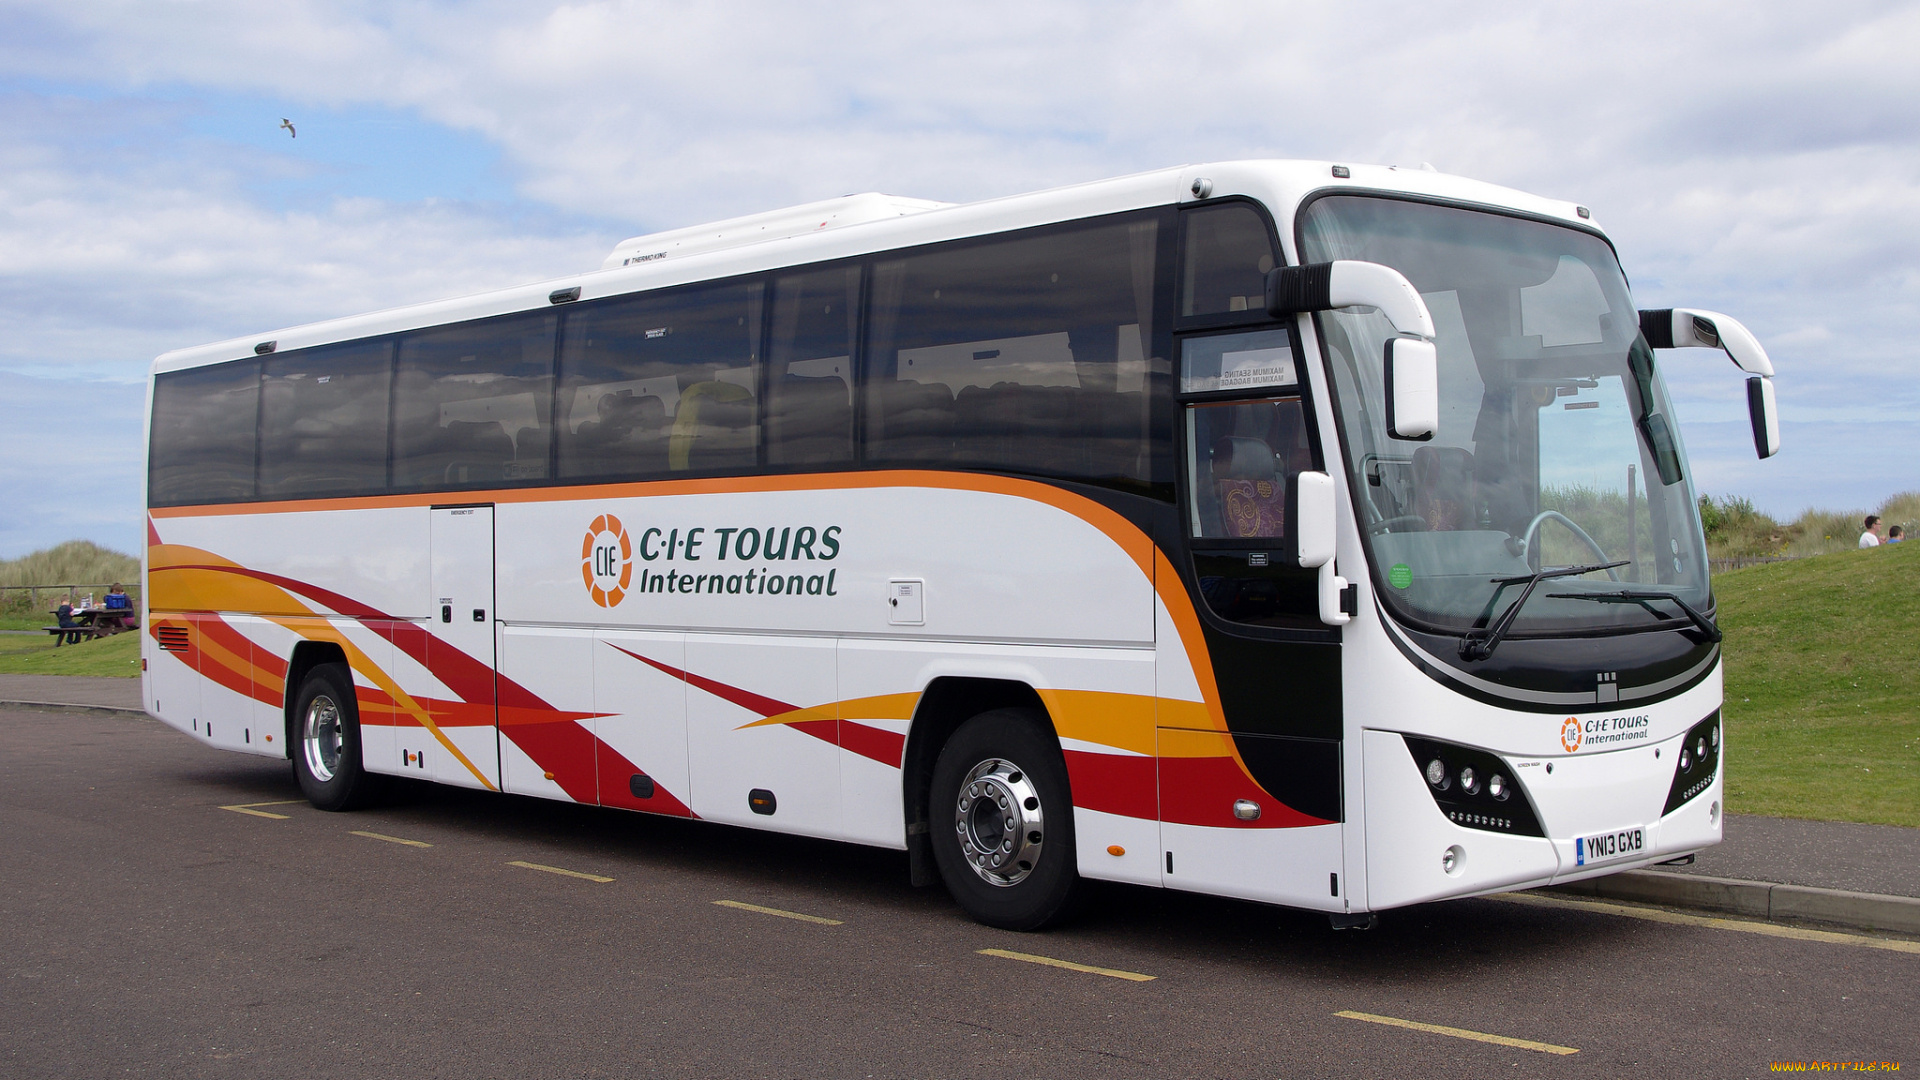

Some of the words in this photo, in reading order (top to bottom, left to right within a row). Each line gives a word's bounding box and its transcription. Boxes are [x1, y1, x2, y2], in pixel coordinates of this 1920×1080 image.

[631, 254, 654, 264] THERMO
[714, 526, 842, 561] TOURS
[596, 546, 616, 577] CIE
[640, 568, 838, 596] International
[1612, 715, 1649, 730] TOURS
[1567, 728, 1576, 741] CIE
[1585, 729, 1648, 745] International
[1587, 835, 1615, 858] YN13
[1618, 829, 1642, 852] GXB
